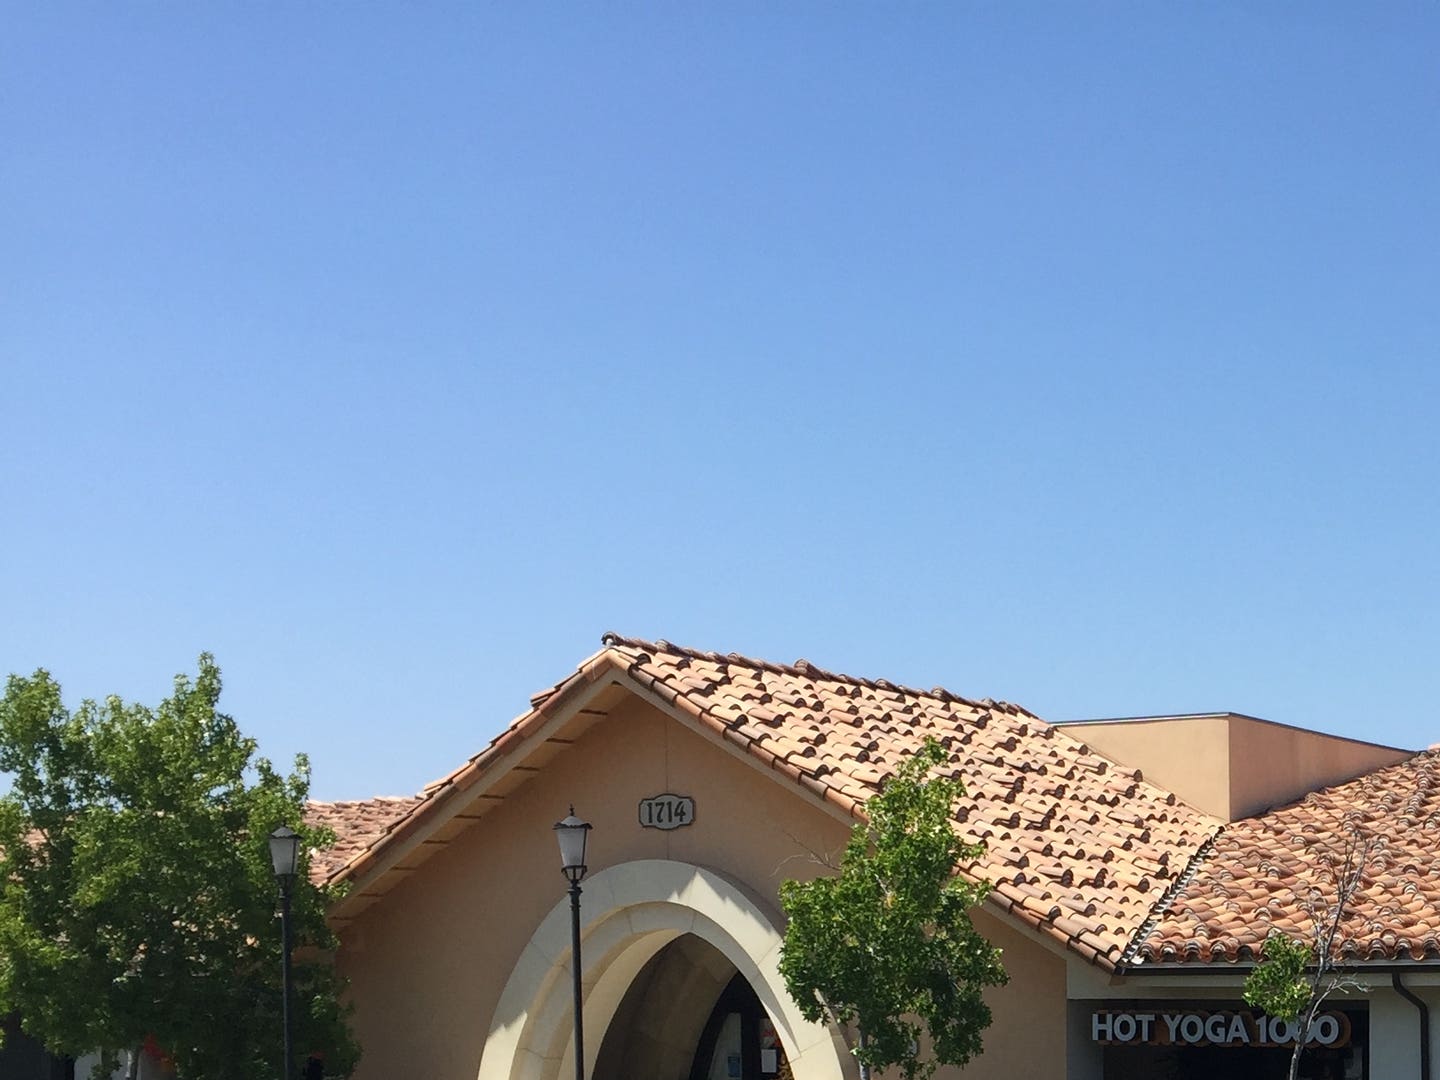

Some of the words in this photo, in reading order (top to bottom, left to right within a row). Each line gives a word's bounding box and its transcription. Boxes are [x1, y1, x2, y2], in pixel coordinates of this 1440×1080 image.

[646, 801, 686, 823] 1714
[1091, 1013, 1154, 1042] HOT
[1162, 1013, 1249, 1044] YOGA
